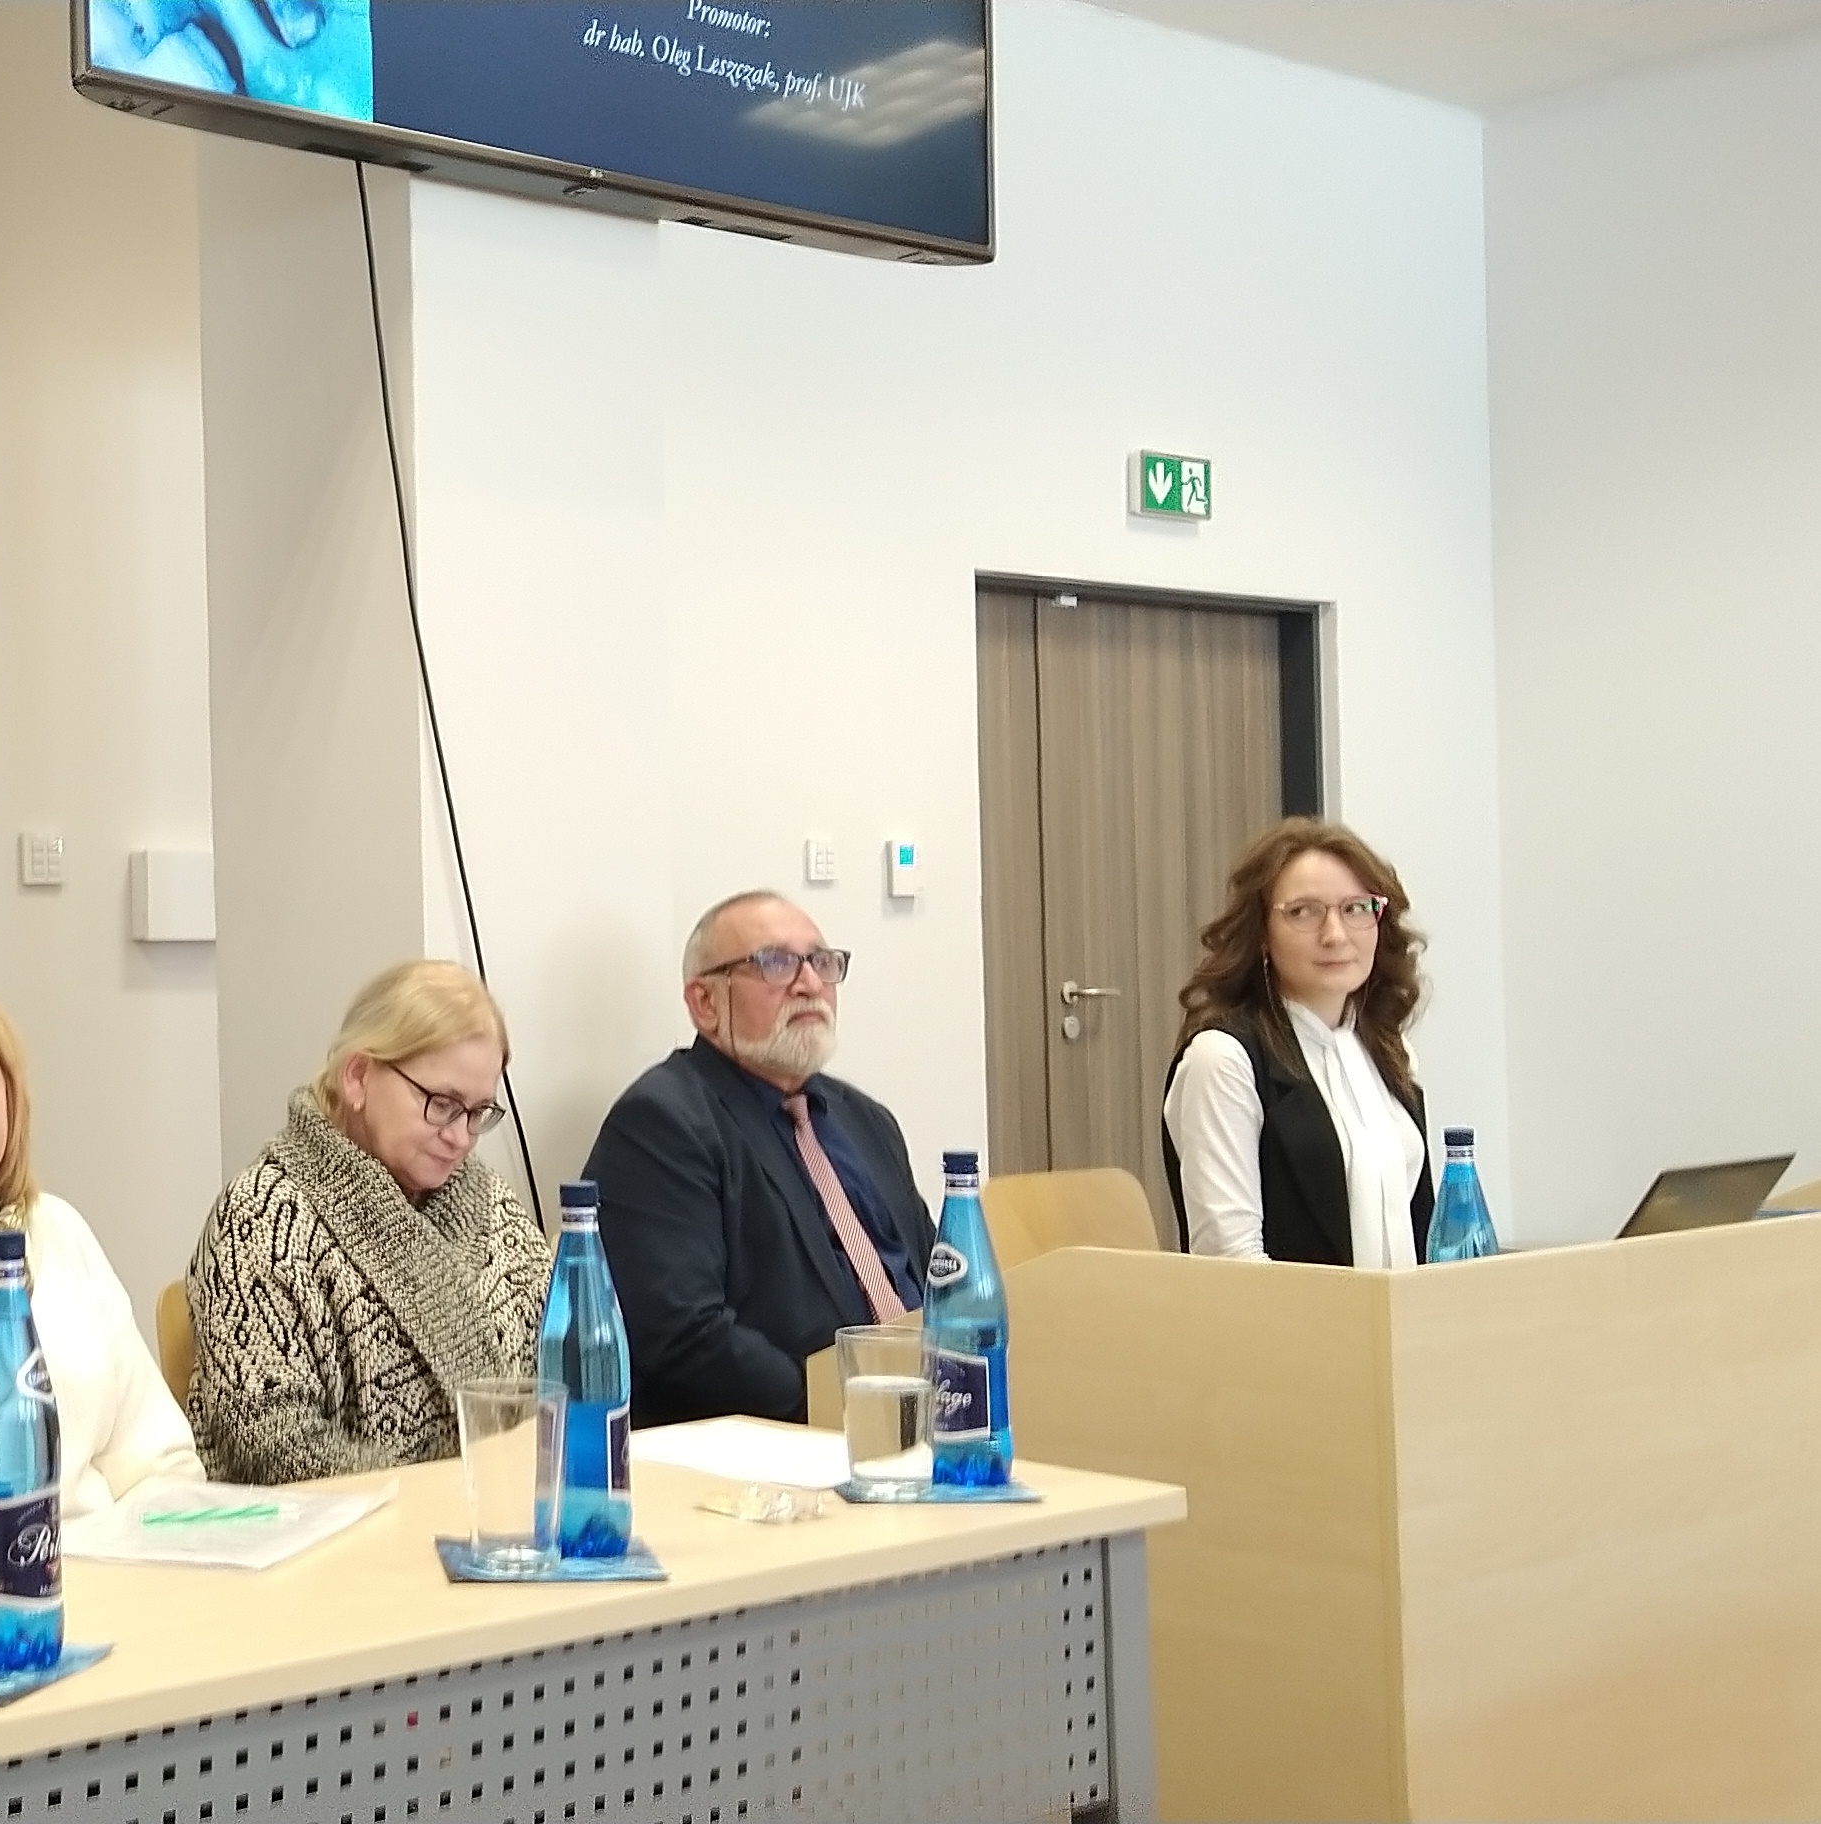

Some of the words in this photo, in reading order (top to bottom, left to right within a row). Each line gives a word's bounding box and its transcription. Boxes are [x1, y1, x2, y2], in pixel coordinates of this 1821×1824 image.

[686, 0, 772, 38] Promotor:
[583, 19, 606, 47] dr
[608, 23, 645, 57] hab.
[652, 35, 691, 76] Oleg
[695, 45, 780, 92] Leszczak,
[782, 70, 822, 105] prof.
[829, 76, 867, 112] UJK
